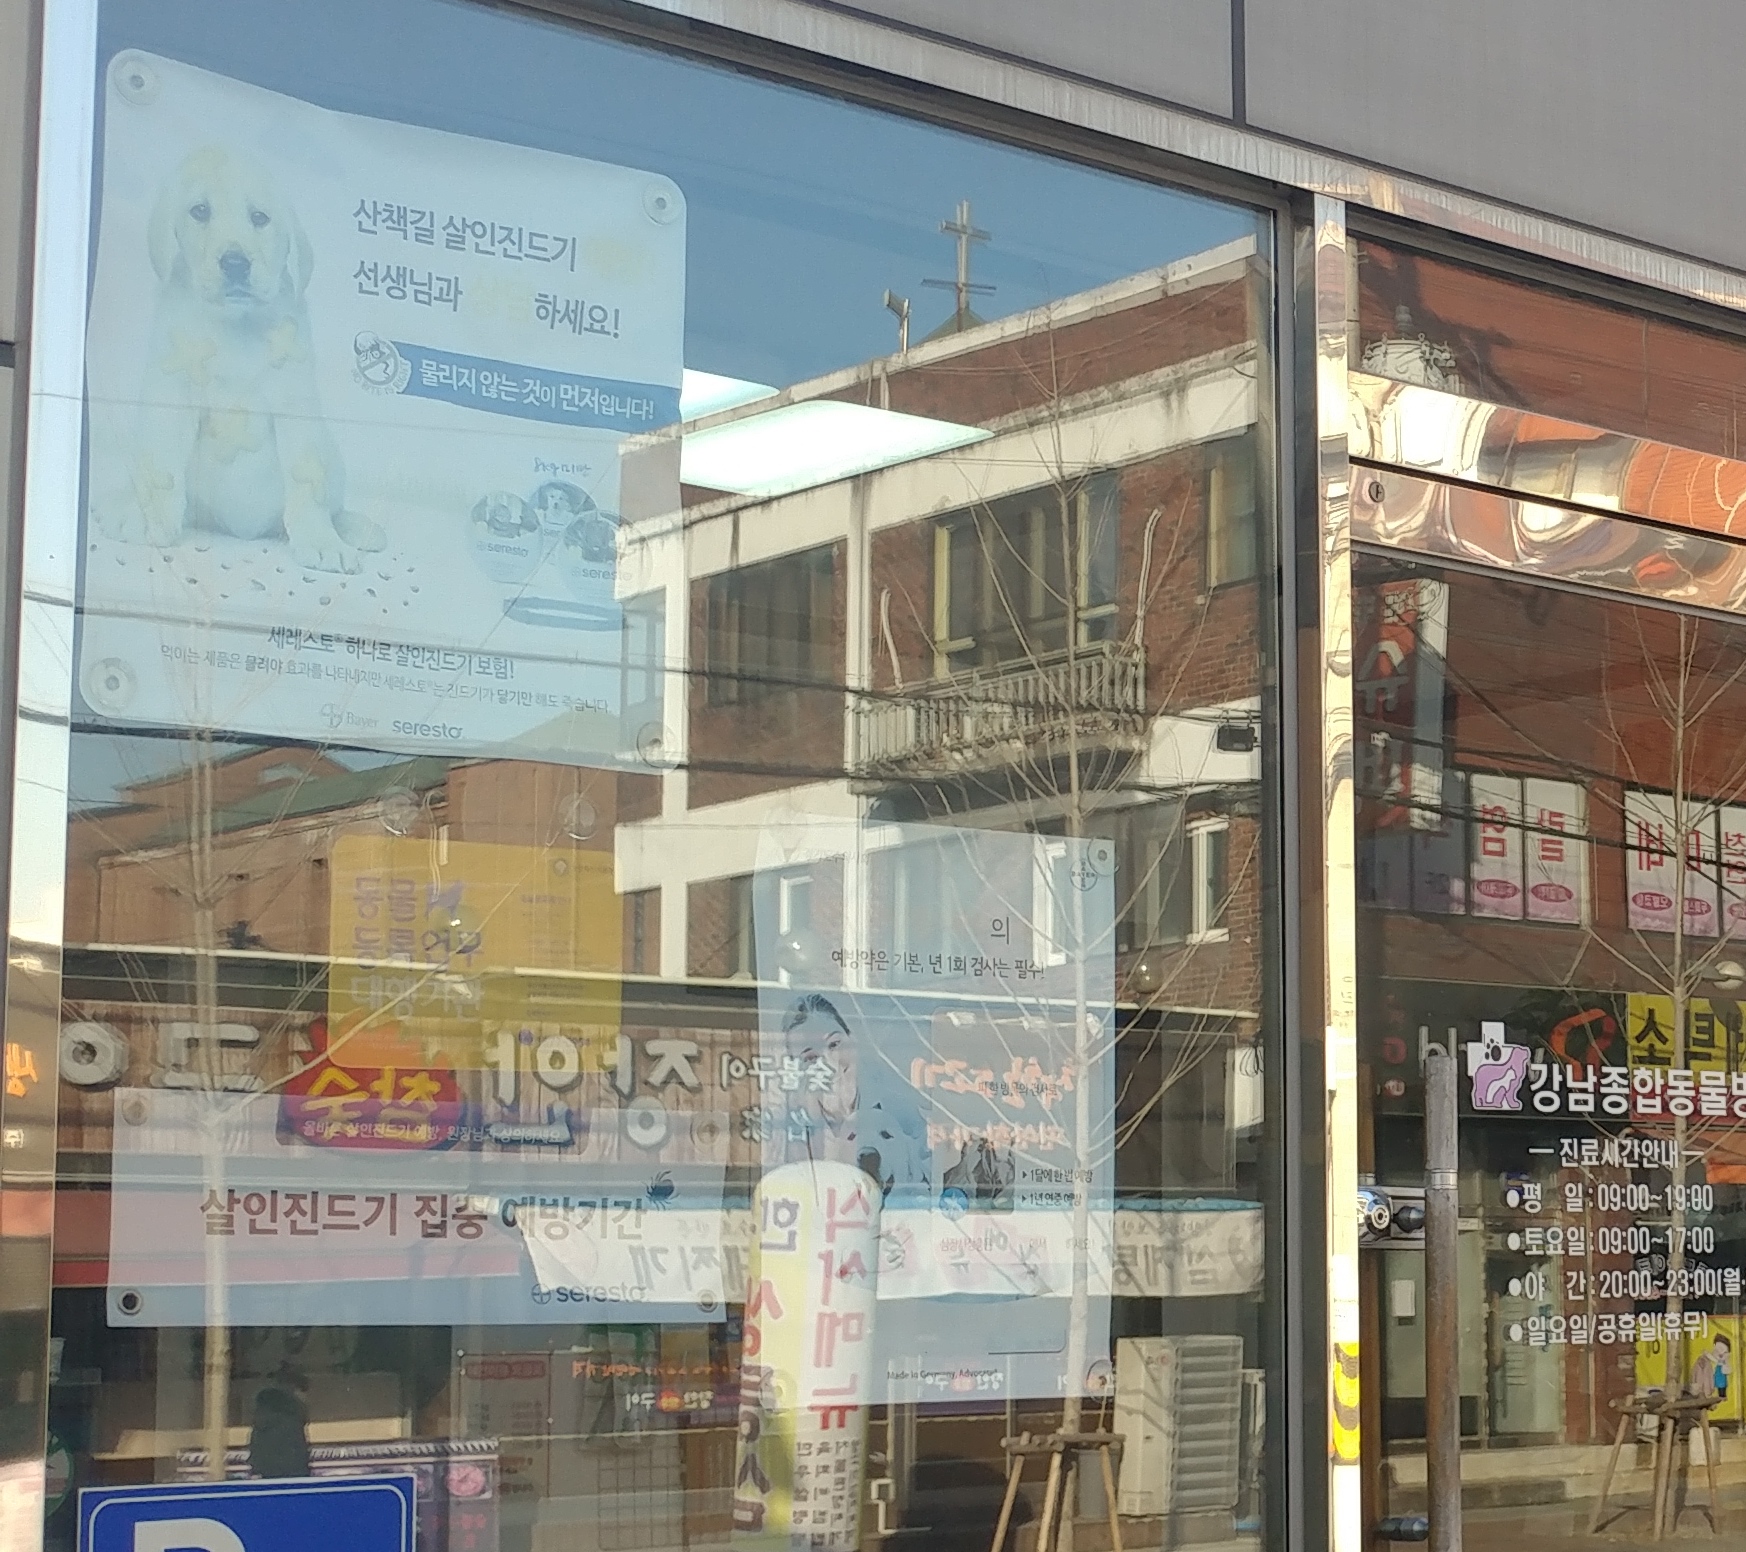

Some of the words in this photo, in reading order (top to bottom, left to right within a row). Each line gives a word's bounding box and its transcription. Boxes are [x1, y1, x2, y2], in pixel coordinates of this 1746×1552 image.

[353, 198, 434, 246] 산책길
[441, 215, 578, 273] 살인진드기
[352, 260, 464, 313] 선생님과
[534, 292, 621, 339] 하세요!
[419, 359, 477, 395] 물리지
[479, 370, 520, 403] 않는
[521, 378, 556, 409] 것이
[345, 636, 392, 663] 하나로
[396, 643, 473, 677] 살인진드기
[474, 655, 515, 680] 보험!
[990, 915, 1011, 945] 의
[830, 949, 890, 973] 예방약은
[893, 951, 926, 974] 기본,
[928, 953, 943, 975] 년
[970, 957, 1012, 978] 검사는
[1014, 960, 1047, 981] 필수!
[1558, 1137, 1680, 1171] 진료시간안내
[200, 1187, 398, 1238] 살인진드기
[413, 1192, 489, 1240] 집중
[500, 1193, 648, 1241] 예방기간
